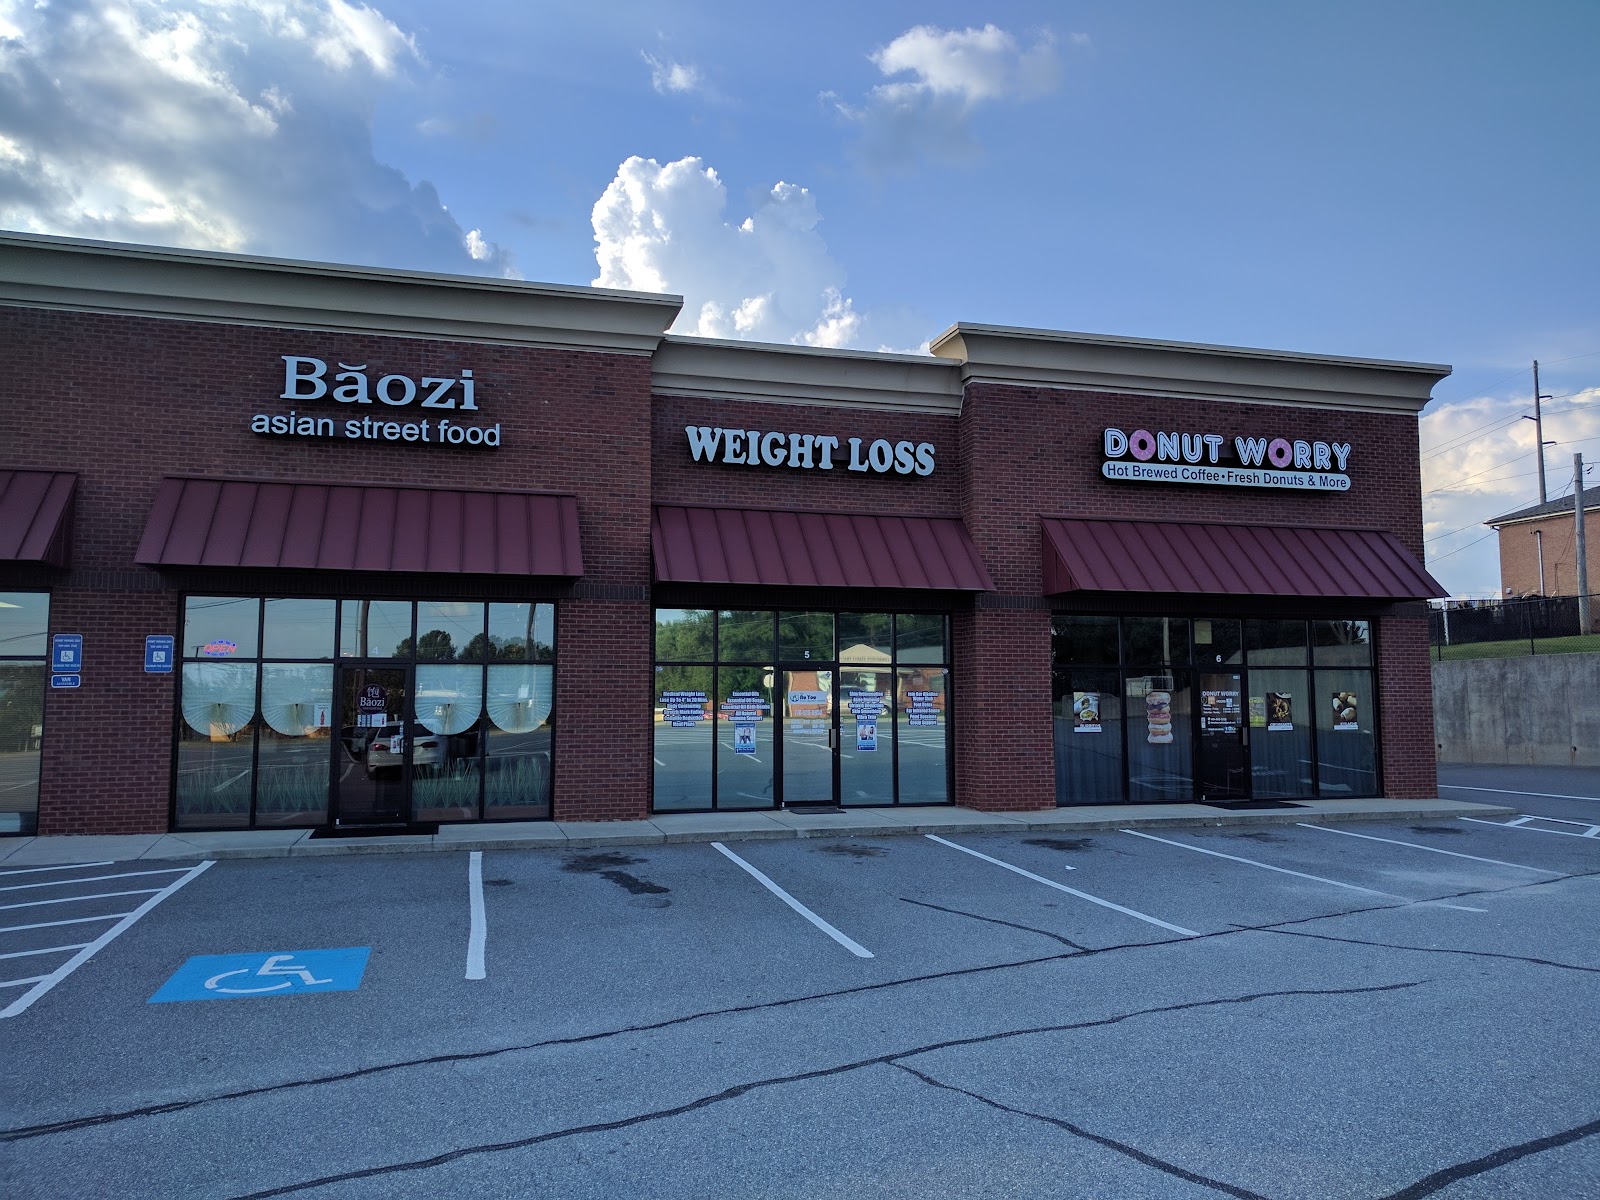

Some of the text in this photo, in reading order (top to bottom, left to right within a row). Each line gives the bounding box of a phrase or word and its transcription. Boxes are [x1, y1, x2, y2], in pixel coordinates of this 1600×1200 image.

[251, 411, 500, 446] asian street food
[685, 425, 935, 476] WEIGHT LOSS
[1104, 428, 1351, 471] DONUT WORRY
[1107, 464, 1129, 476] Hot
[1133, 466, 1178, 479] Brewed
[1264, 473, 1304, 486] Donuts
[1308, 475, 1316, 486] &
[1319, 476, 1347, 488] More
[204, 644, 236, 654] OPEN
[372, 646, 379, 654] 4
